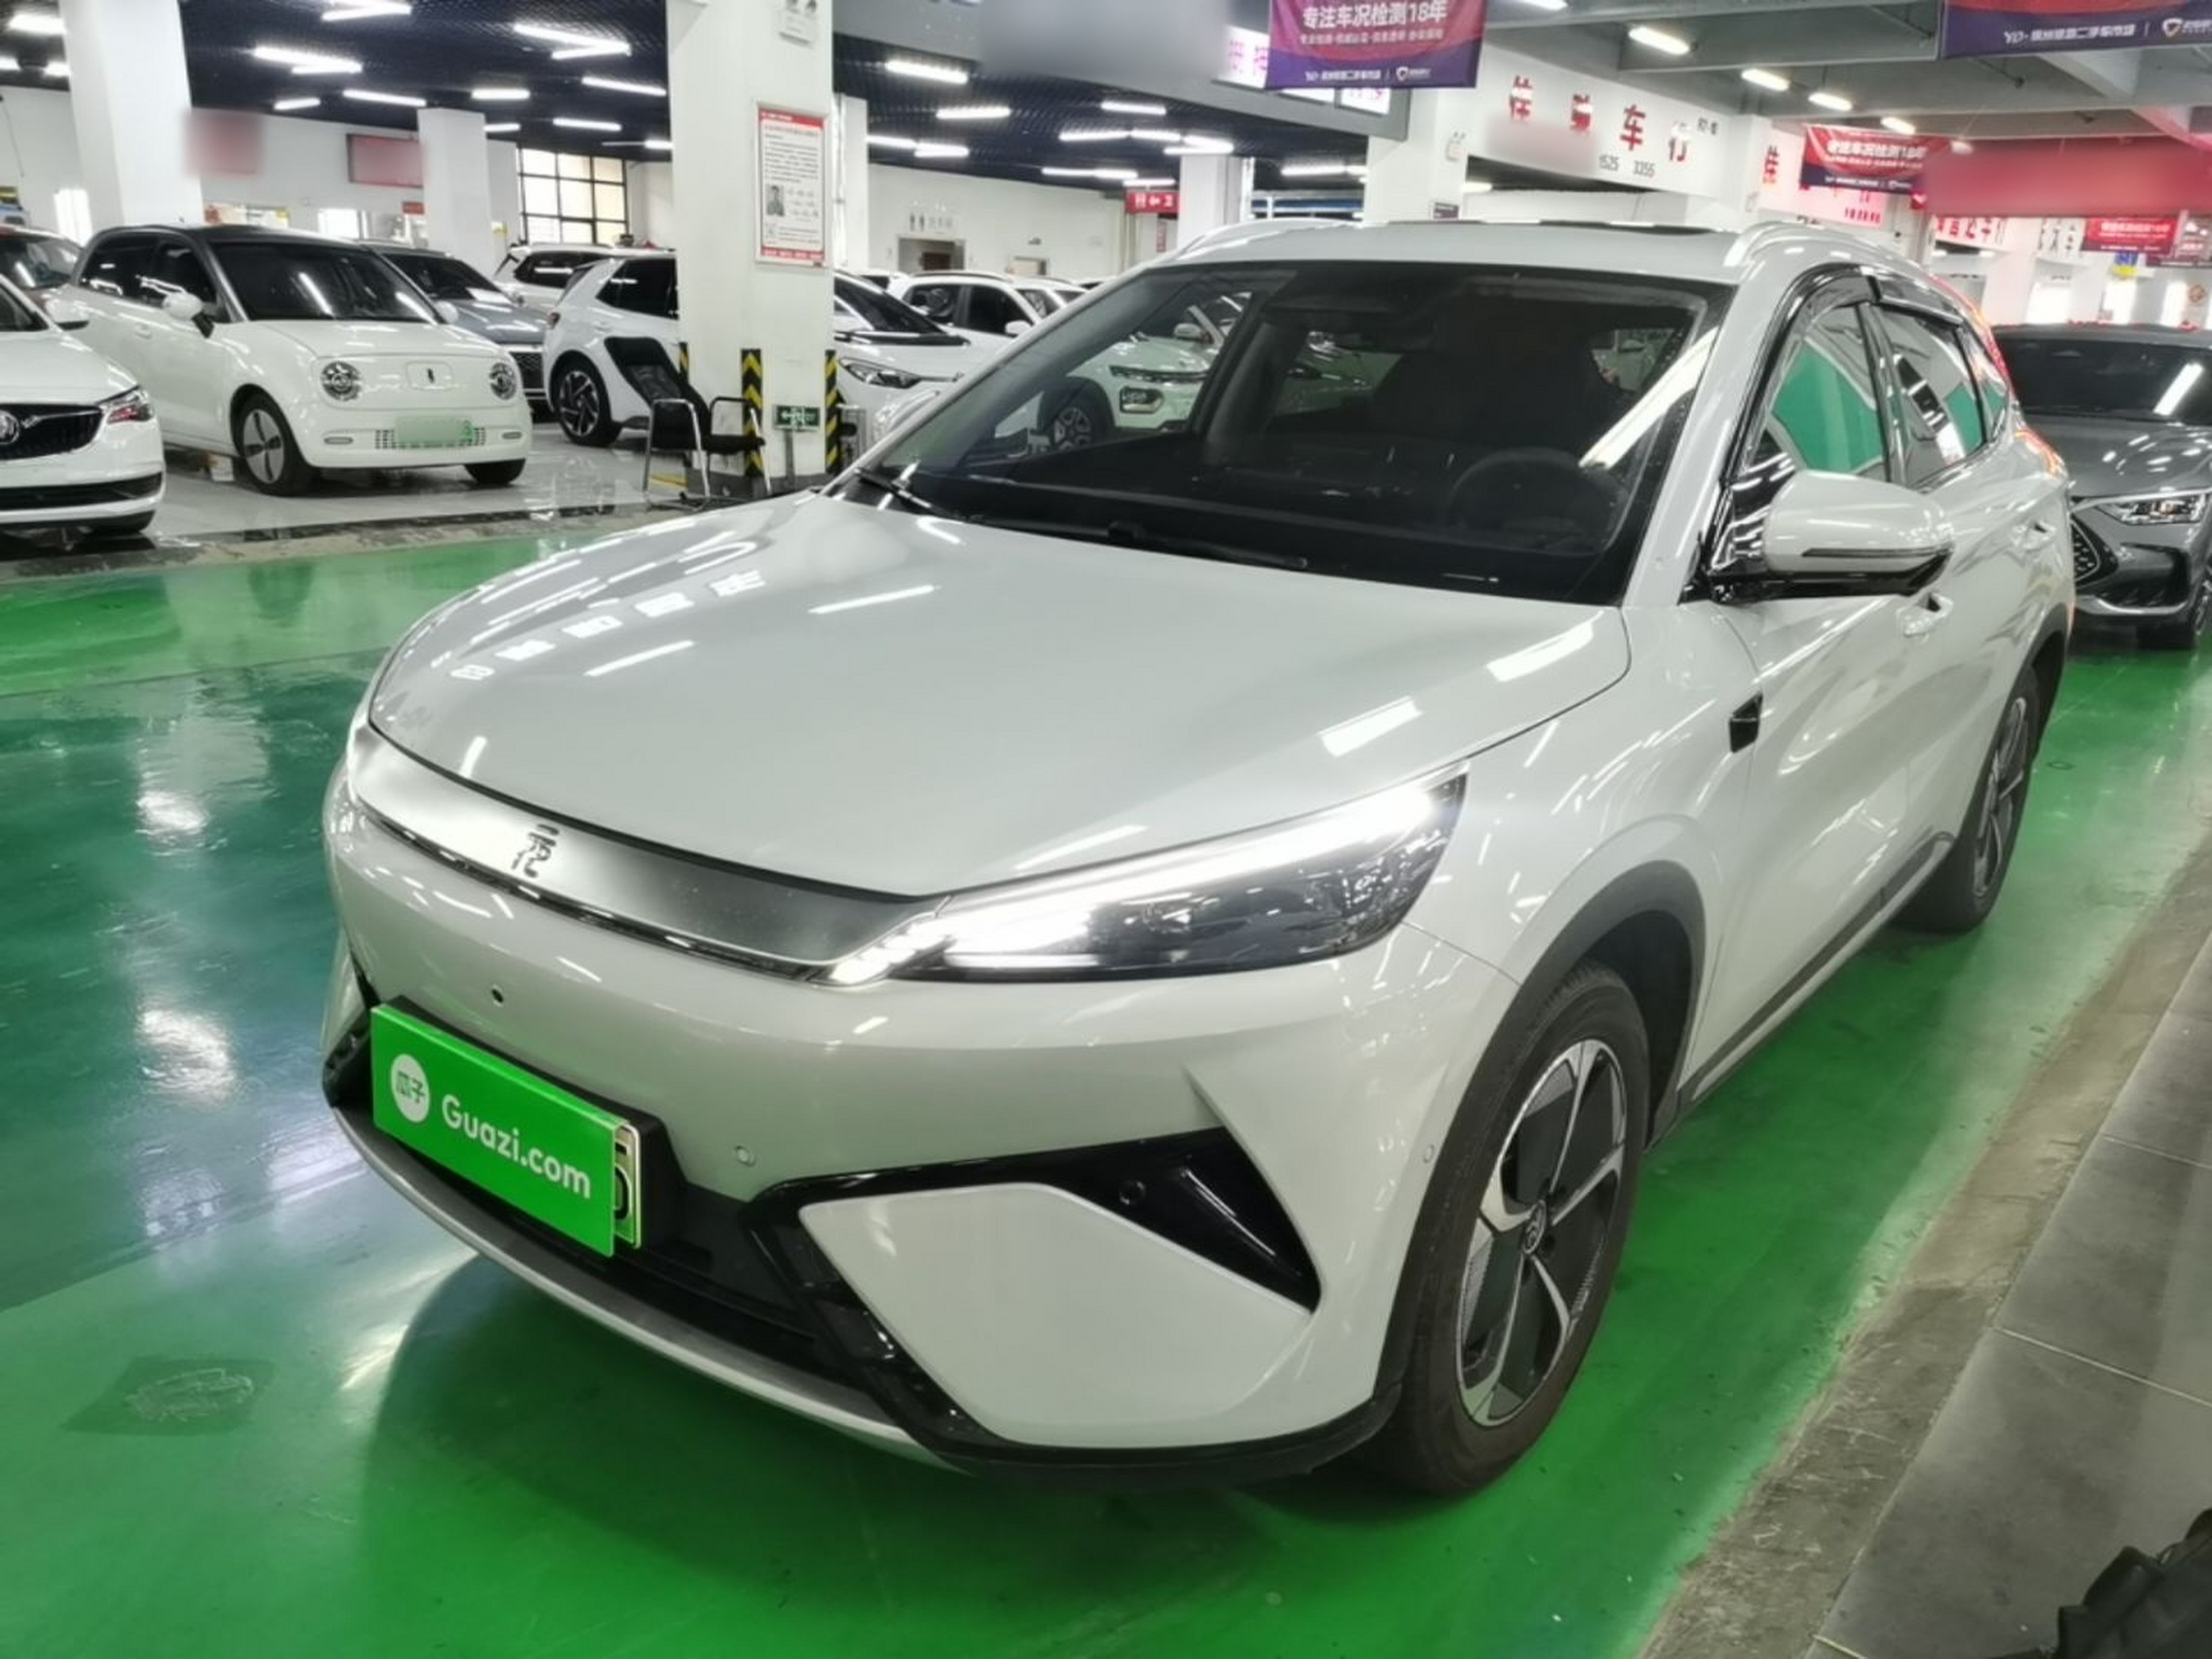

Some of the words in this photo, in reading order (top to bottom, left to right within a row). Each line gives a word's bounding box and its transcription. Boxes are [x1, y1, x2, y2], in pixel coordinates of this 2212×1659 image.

[1303, 1, 1447, 28] 专注车况检测18年
[442, 1093, 591, 1199] Guazi.com
